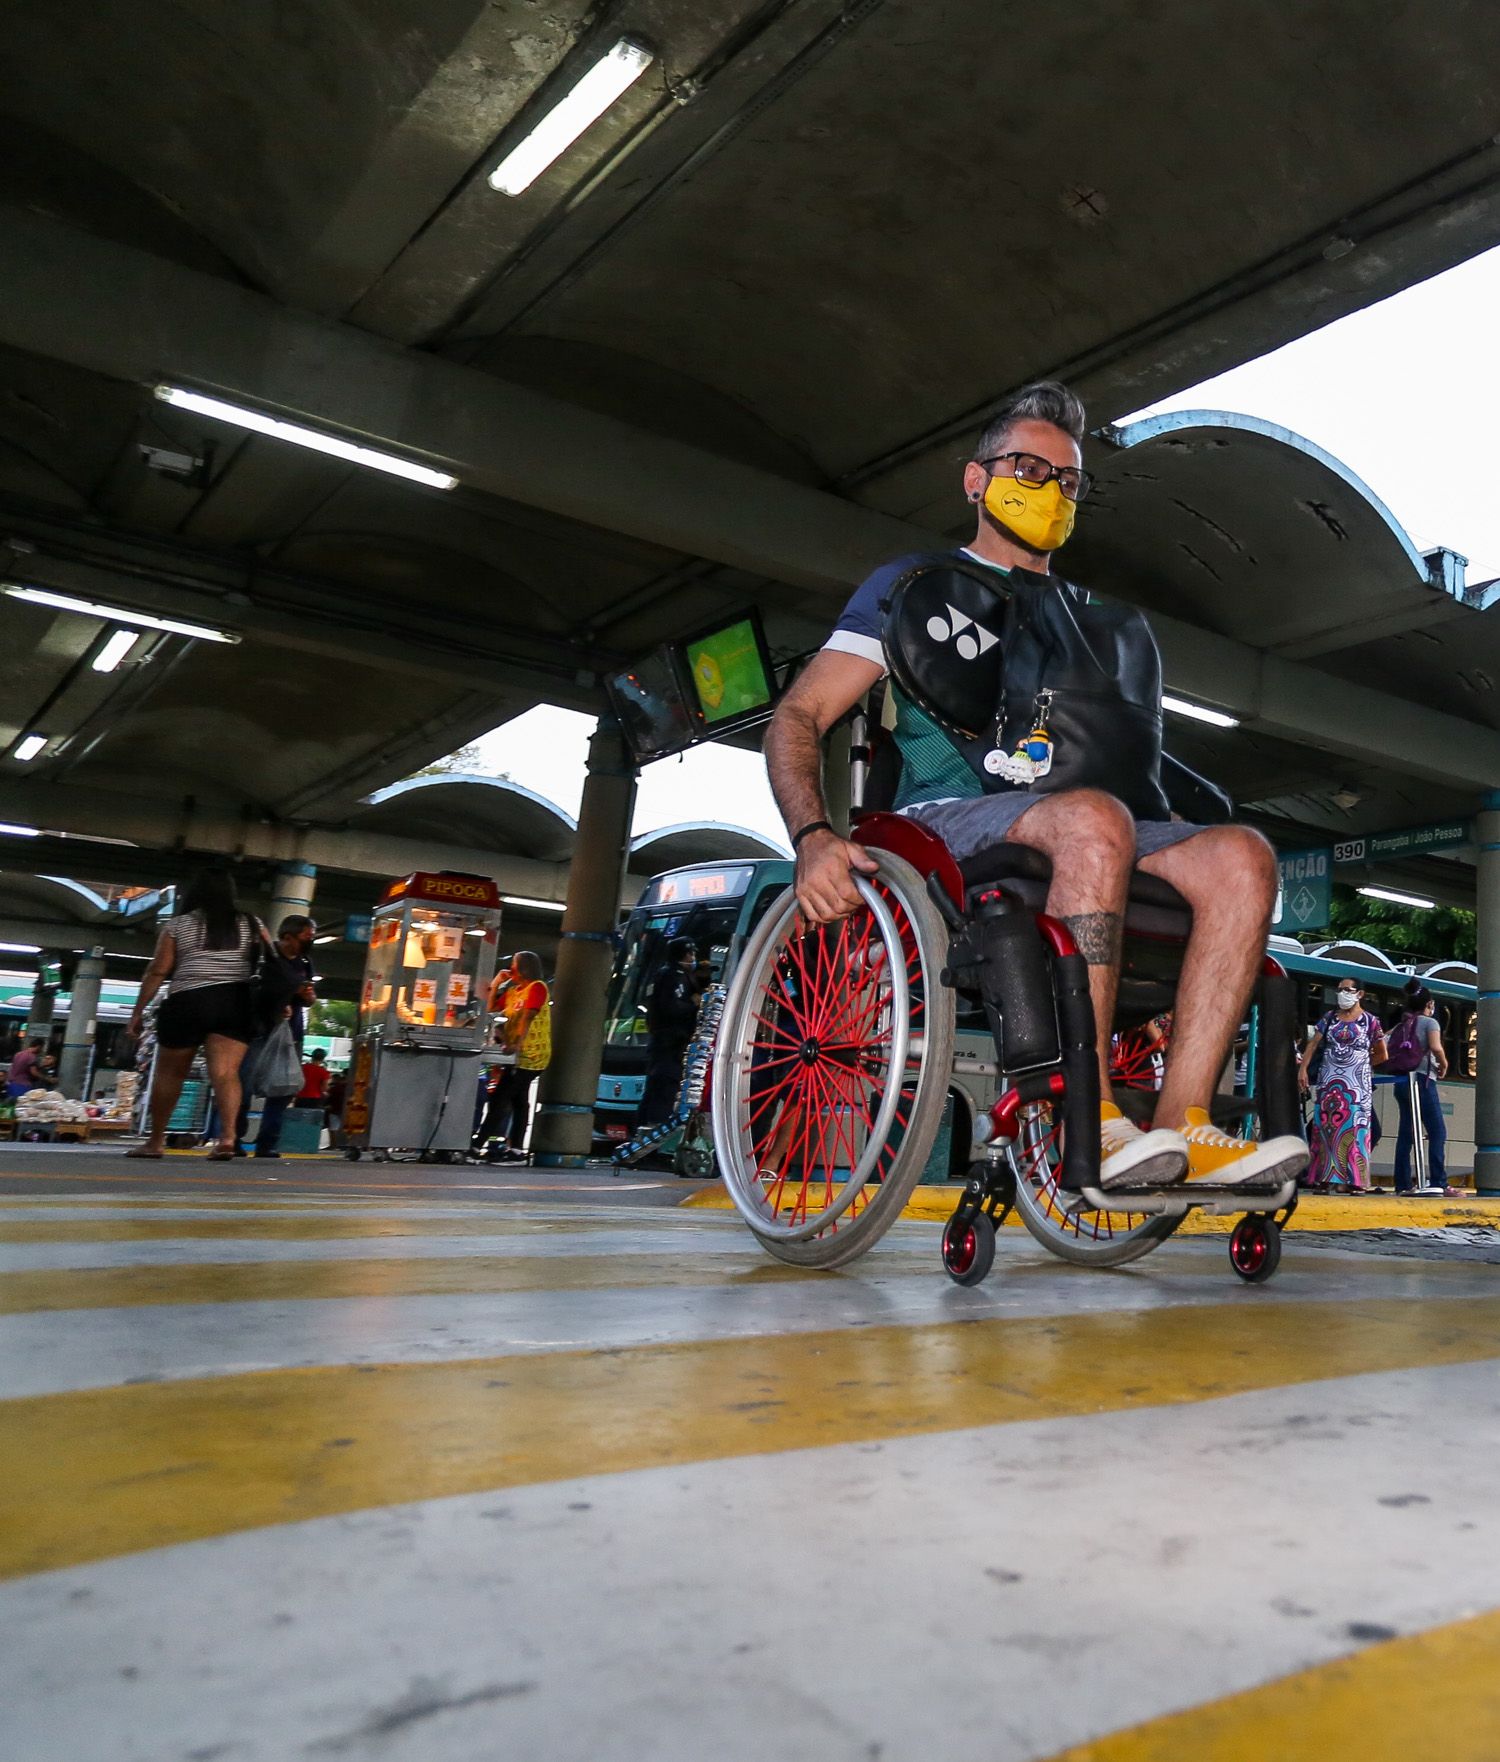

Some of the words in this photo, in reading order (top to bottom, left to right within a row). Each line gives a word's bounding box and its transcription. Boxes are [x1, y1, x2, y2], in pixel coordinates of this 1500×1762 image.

[1335, 842, 1364, 861] 390
[1371, 835, 1409, 851] Parangaba
[1415, 831, 1433, 844] João
[1434, 827, 1463, 841] Pessoa
[1278, 853, 1327, 883] ENÇÃO
[425, 880, 486, 899] PIPOCA
